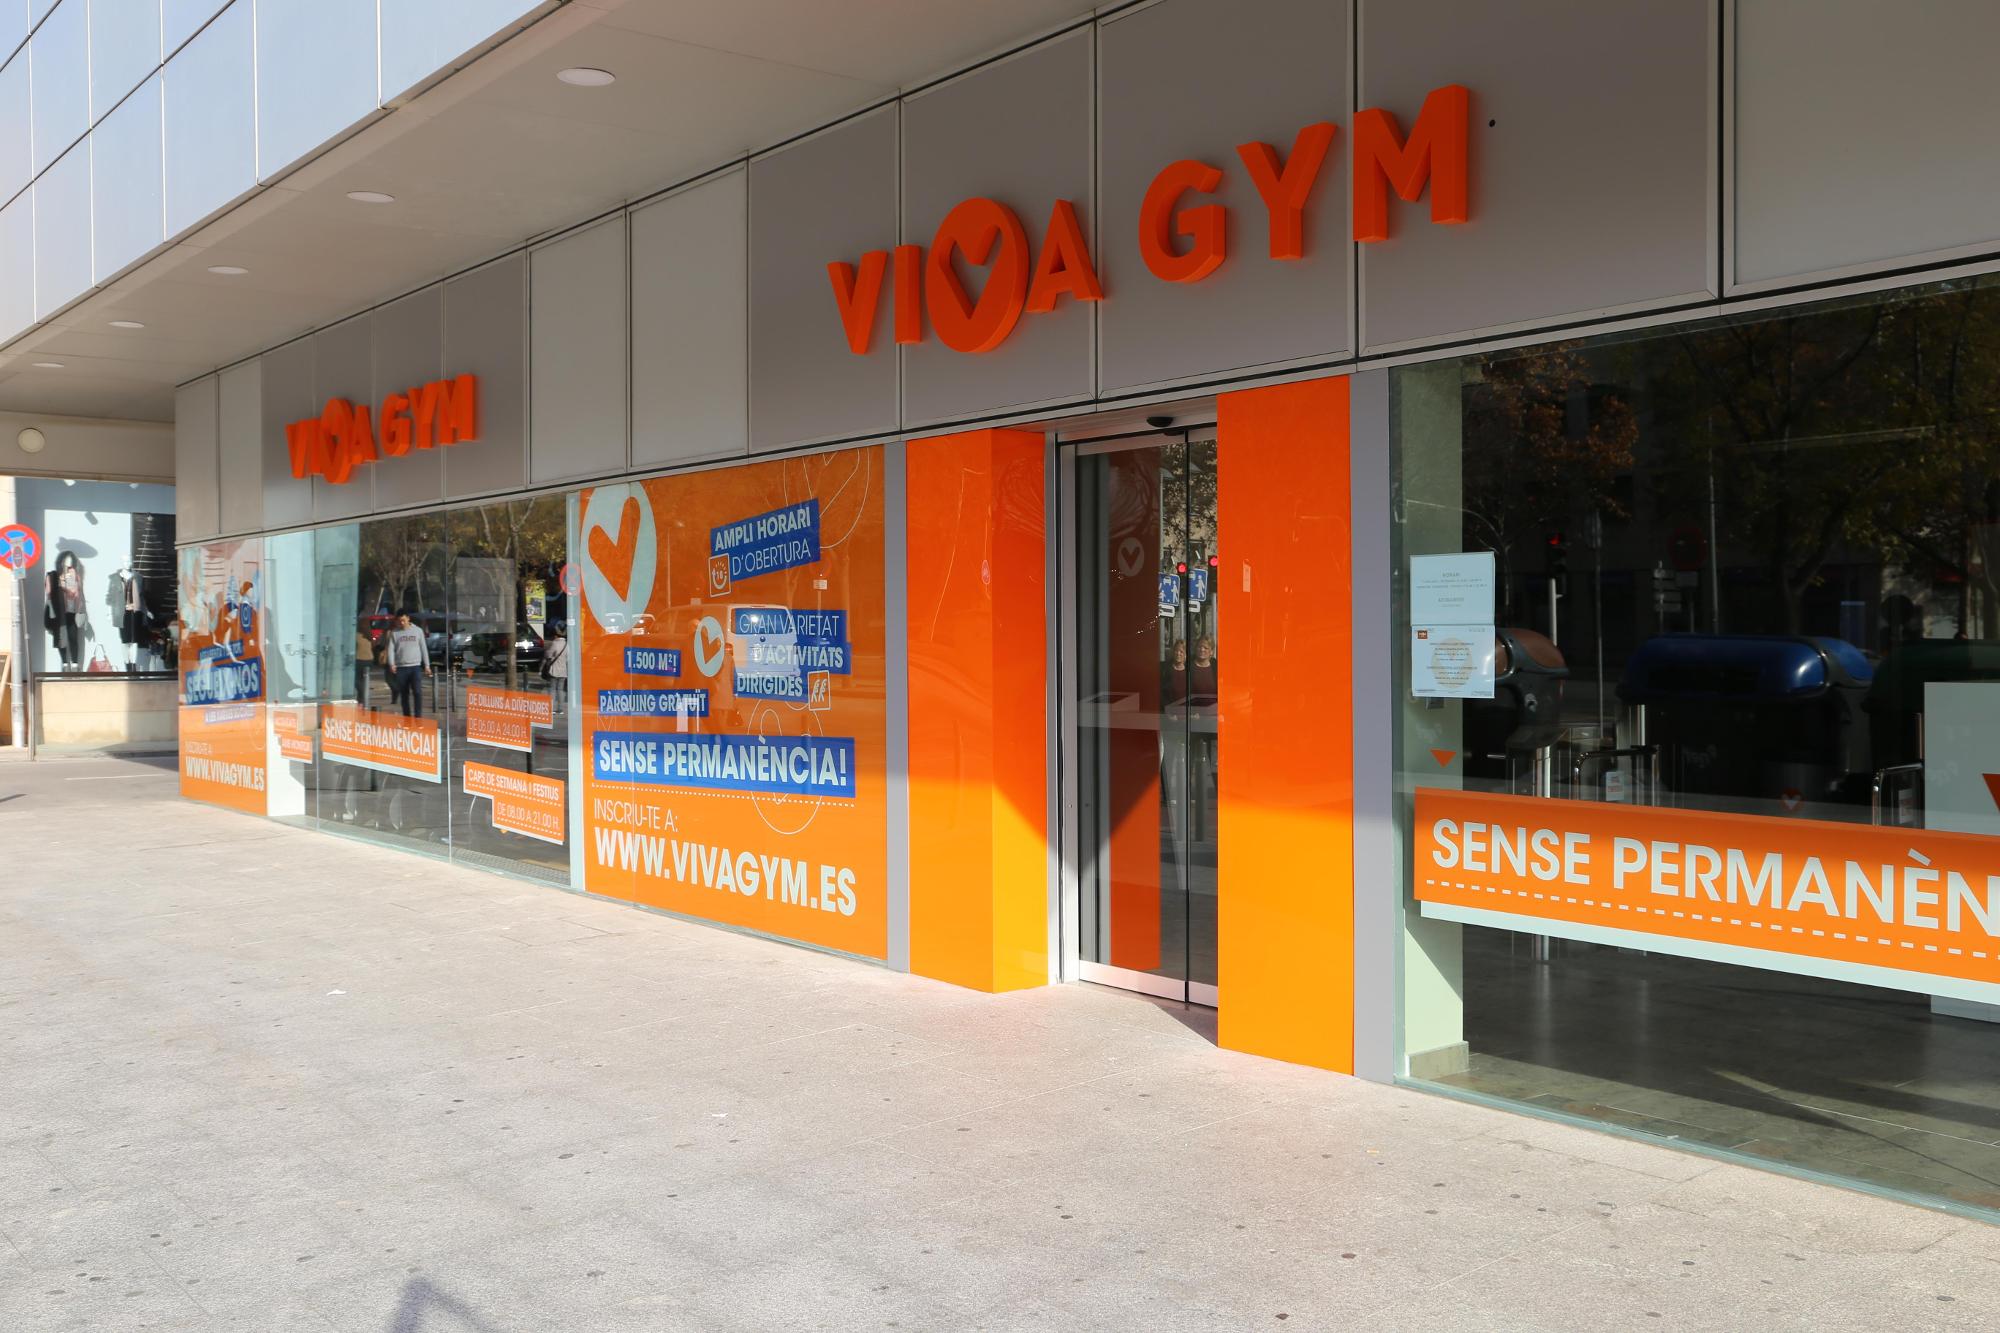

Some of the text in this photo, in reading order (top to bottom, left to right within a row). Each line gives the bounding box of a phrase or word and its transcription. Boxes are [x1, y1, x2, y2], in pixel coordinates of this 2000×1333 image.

[1138, 84, 1470, 284] GYM
[380, 373, 476, 457] GYM
[715, 507, 811, 552] AMPLI HORARI
[732, 538, 811, 576] D'OBERTURA
[740, 613, 840, 637] GRAN VARIETAT
[627, 650, 655, 670] 1.500
[752, 643, 844, 668] D'ACTIVITATS
[600, 691, 656, 712] PÀRQUING
[737, 673, 803, 697] DIRIGIDES
[469, 693, 549, 716] DE DILLUNS A DIVENDRES
[325, 717, 435, 758] SENSE PERMANÈNCIA!
[469, 718, 477, 731] DE
[185, 755, 264, 792] WWW.VIVAGYM.ES
[599, 734, 847, 787] SENSE PERMANÈNCIA!
[468, 769, 485, 783] CAPS
[487, 773, 494, 785] DE
[496, 775, 528, 793] SETMANA
[533, 783, 559, 801] FESTIUS
[497, 802, 506, 816] DE
[593, 798, 679, 833] INSCRIU-TE A:
[1432, 818, 1590, 885] SENSE
[594, 826, 857, 917] WWW.VIVAGYM.ES
